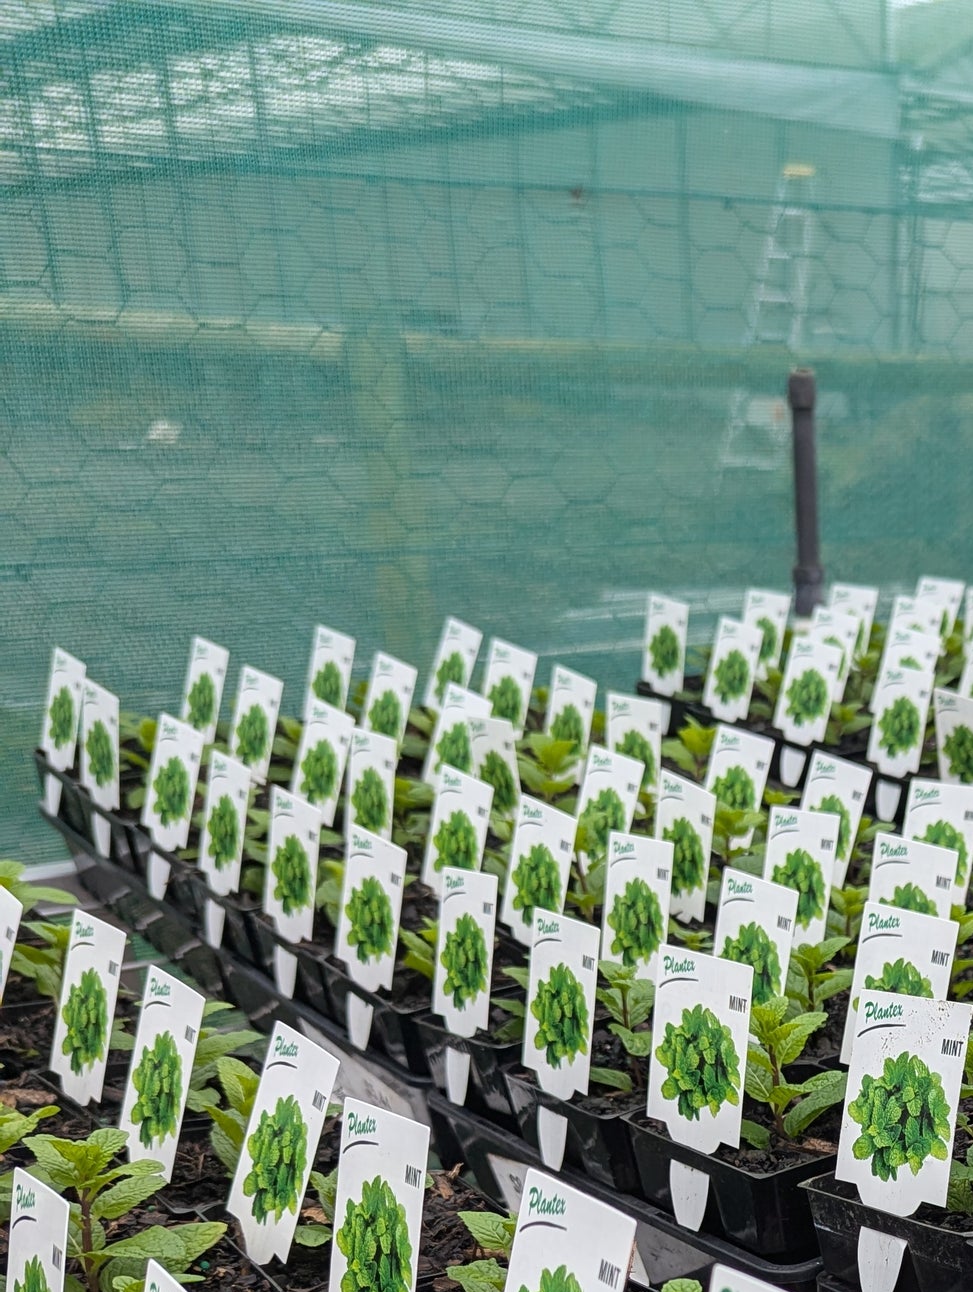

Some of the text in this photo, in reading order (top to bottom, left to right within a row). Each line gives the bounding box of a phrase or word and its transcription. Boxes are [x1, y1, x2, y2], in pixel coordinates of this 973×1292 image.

[880, 842, 908, 858] Plantex
[727, 878, 753, 895] Plantex
[537, 918, 560, 935] Plantex
[777, 916, 792, 931] MINT
[869, 913, 901, 930] Plantex
[663, 955, 695, 973] Plantex
[931, 950, 950, 966] MINT
[729, 995, 747, 1013] MINT
[865, 1001, 903, 1022] Plantex
[273, 1035, 299, 1058] Plantex
[941, 1039, 964, 1057] MINT
[348, 1112, 377, 1136] Plantex
[405, 1165, 422, 1188] MINT
[529, 1187, 567, 1216] Plantex
[598, 1258, 621, 1290] MINT
